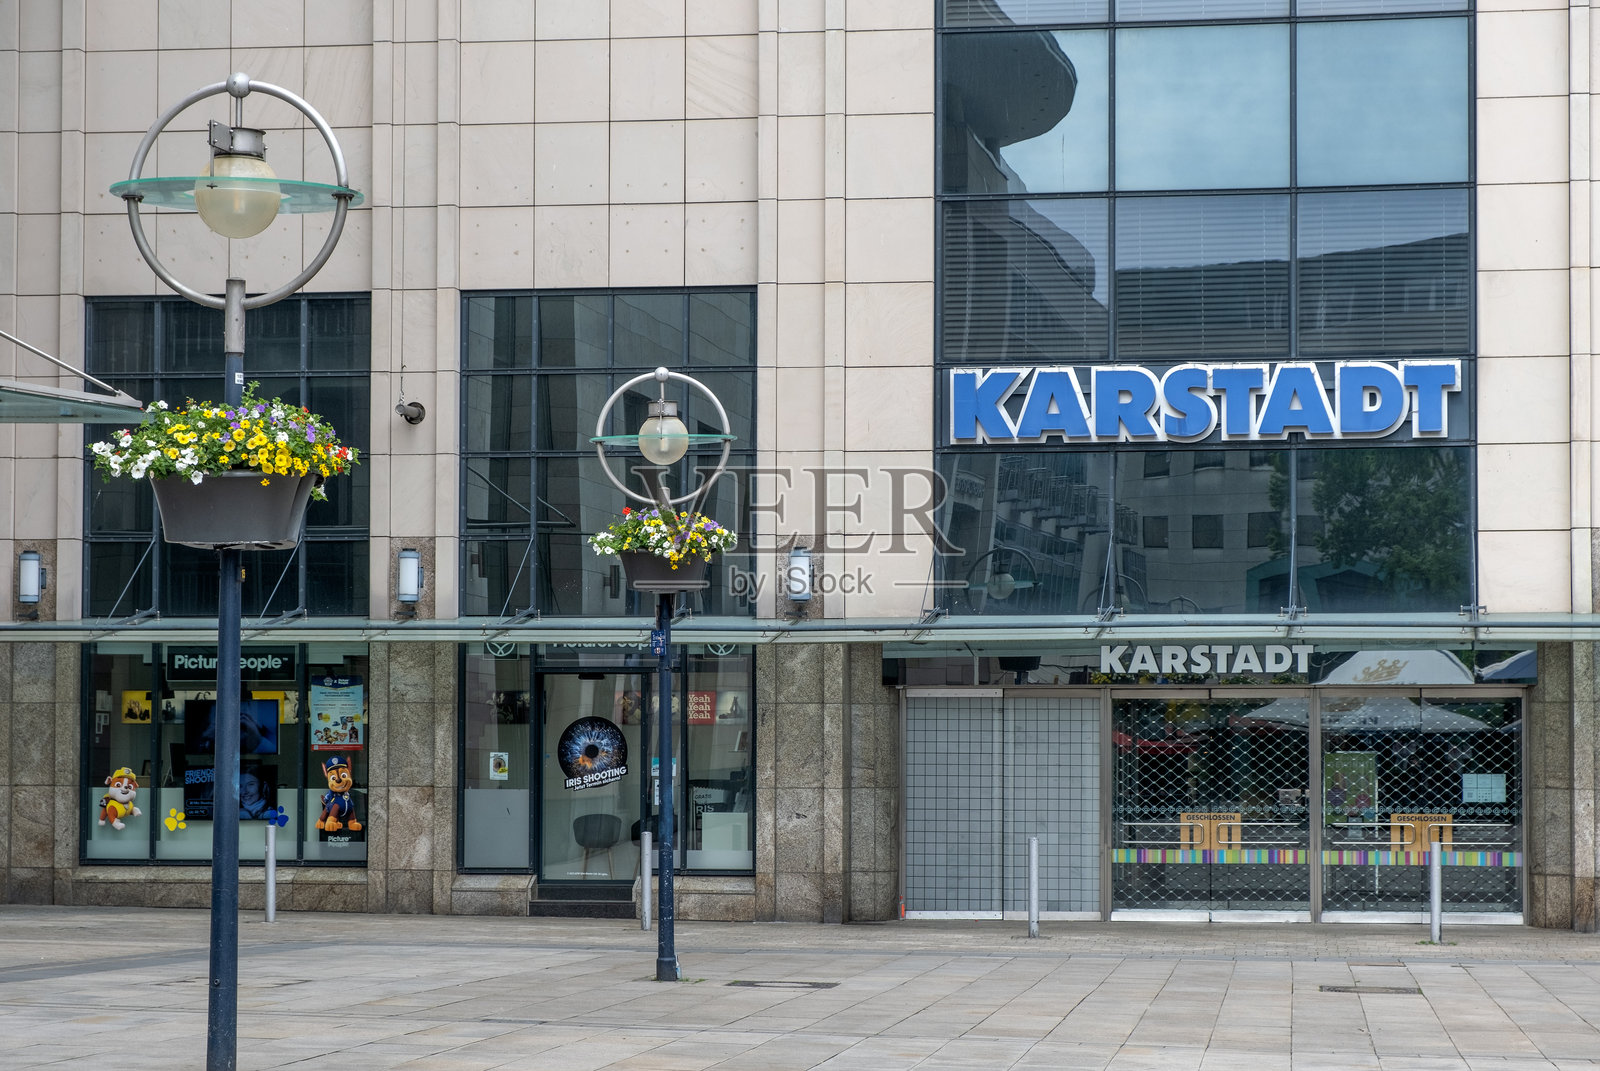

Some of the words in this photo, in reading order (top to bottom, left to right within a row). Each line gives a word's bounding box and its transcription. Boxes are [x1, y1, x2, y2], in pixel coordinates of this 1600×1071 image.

[949, 360, 1462, 444] KARSTADT
[1100, 645, 1314, 673] KARSTADT
[688, 694, 711, 703] Yeah
[688, 702, 711, 711] Yeah
[688, 711, 711, 719] Yeah
[185, 775, 214, 784] SHOOTI
[566, 777, 581, 787] IRIS
[583, 766, 627, 783] SHOOTING
[586, 780, 602, 788] Termin
